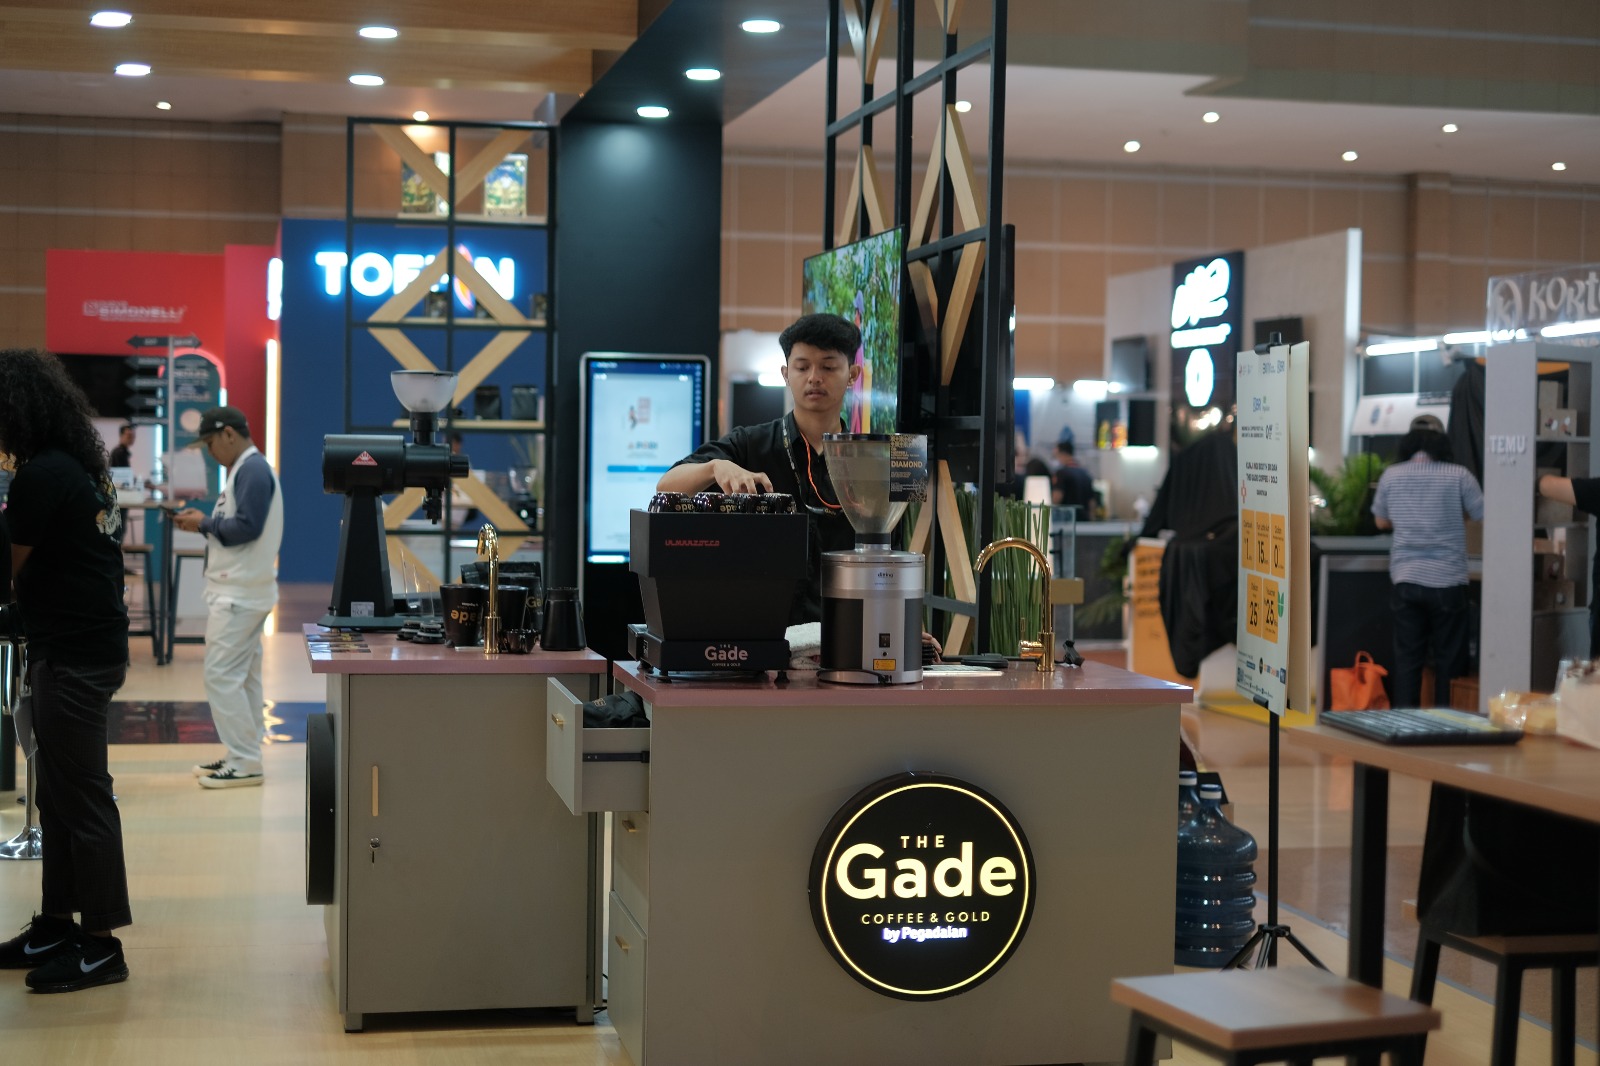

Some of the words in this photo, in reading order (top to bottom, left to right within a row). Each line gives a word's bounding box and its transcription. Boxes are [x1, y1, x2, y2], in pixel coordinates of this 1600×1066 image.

[1489, 435, 1527, 453] TEMU
[1257, 540, 1265, 564] 15
[1249, 601, 1258, 627] 25
[1265, 599, 1275, 625] 25
[704, 645, 749, 661] Gade
[900, 835, 945, 849] THE
[835, 841, 1017, 900] Gade
[861, 912, 924, 925] COFFEE
[930, 912, 939, 923] &
[945, 911, 990, 923] GOLD
[882, 926, 900, 943] by
[901, 924, 968, 942] Pegadaian
